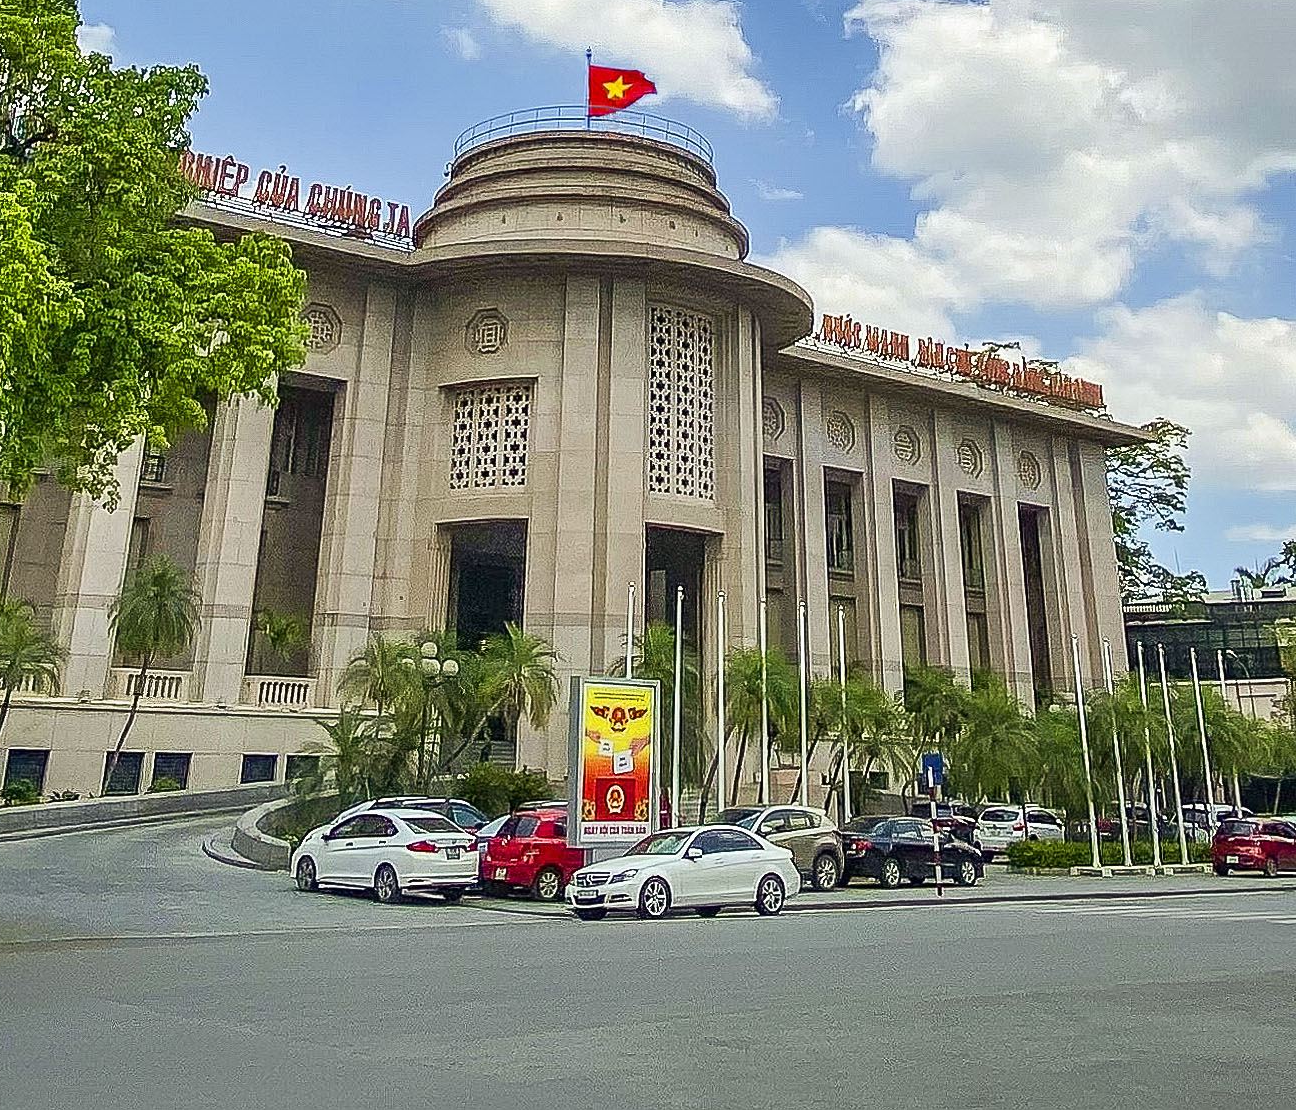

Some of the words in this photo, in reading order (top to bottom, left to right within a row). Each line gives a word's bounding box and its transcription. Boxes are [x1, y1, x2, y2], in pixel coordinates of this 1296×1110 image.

[256, 165, 299, 211] CỦA
[307, 183, 382, 231] CHÚNG
[387, 201, 410, 238] TA
